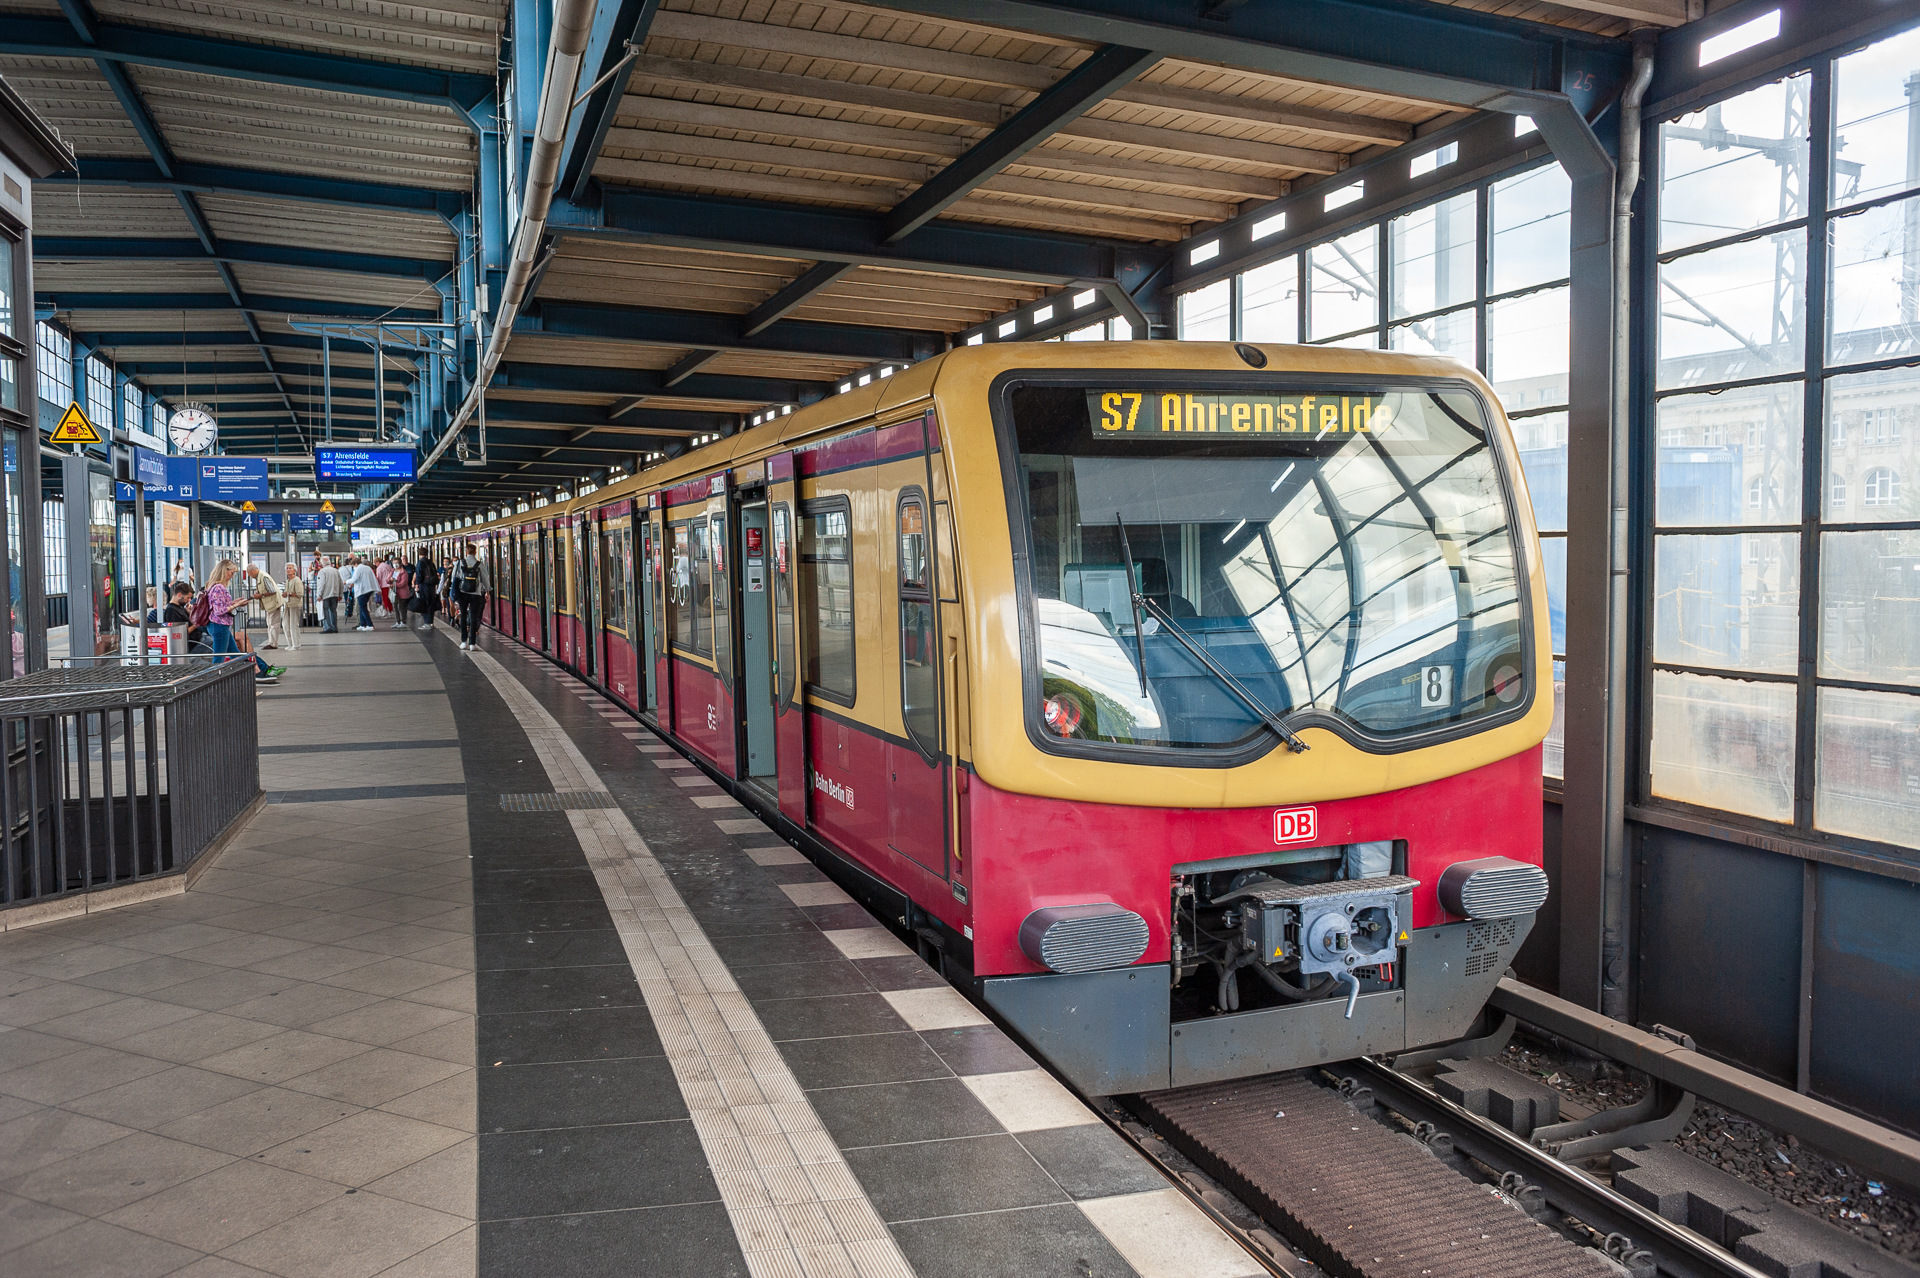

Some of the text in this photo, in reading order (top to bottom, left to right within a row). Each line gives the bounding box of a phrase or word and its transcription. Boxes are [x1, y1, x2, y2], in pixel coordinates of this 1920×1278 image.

[1573, 70, 1595, 92] 25
[1101, 392, 1393, 433] S7 Ahrensfelde
[335, 452, 370, 460] Ahrensfelde
[243, 514, 253, 527] 4
[325, 514, 334, 527] 3
[1426, 666, 1442, 702] 8
[815, 771, 829, 794] Bahn
[828, 778, 845, 804] Berlin
[1280, 813, 1312, 838] DB
